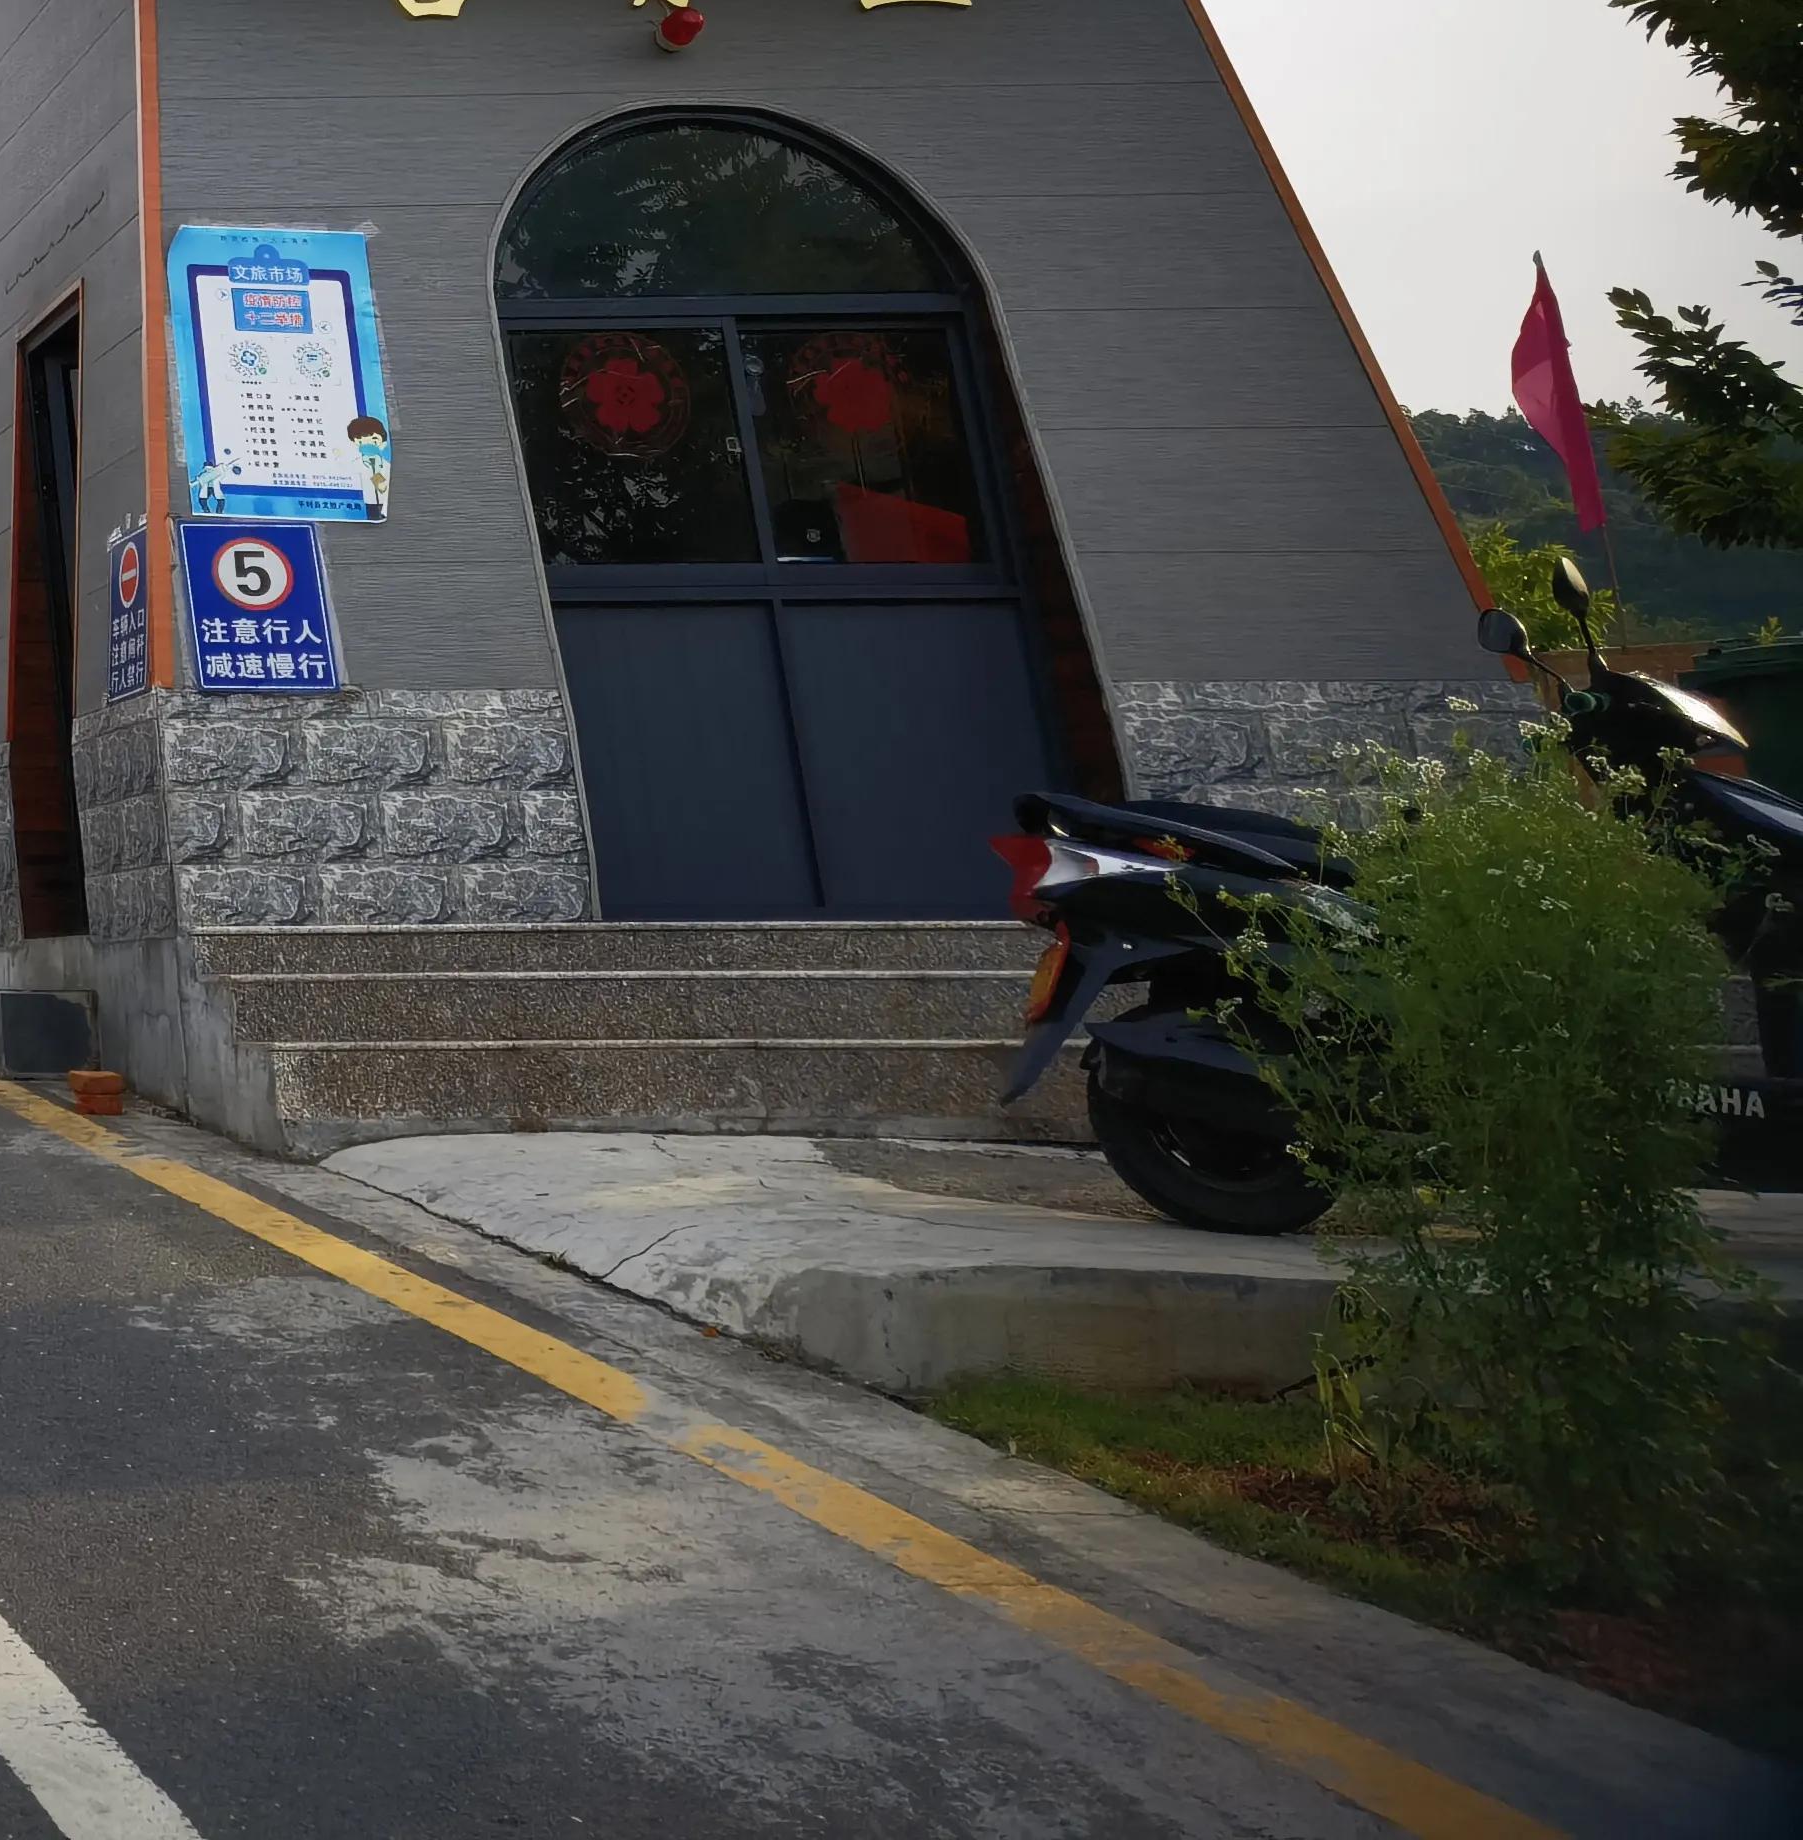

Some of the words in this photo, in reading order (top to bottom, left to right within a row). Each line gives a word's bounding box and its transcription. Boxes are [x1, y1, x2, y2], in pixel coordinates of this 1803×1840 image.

[232, 265, 303, 283] 文旅市场
[234, 550, 271, 597] 5
[112, 608, 145, 640] 车辆入口
[200, 617, 323, 645] 注意行人
[112, 661, 144, 693] 行人禁行
[205, 652, 328, 679] 减速慢行
